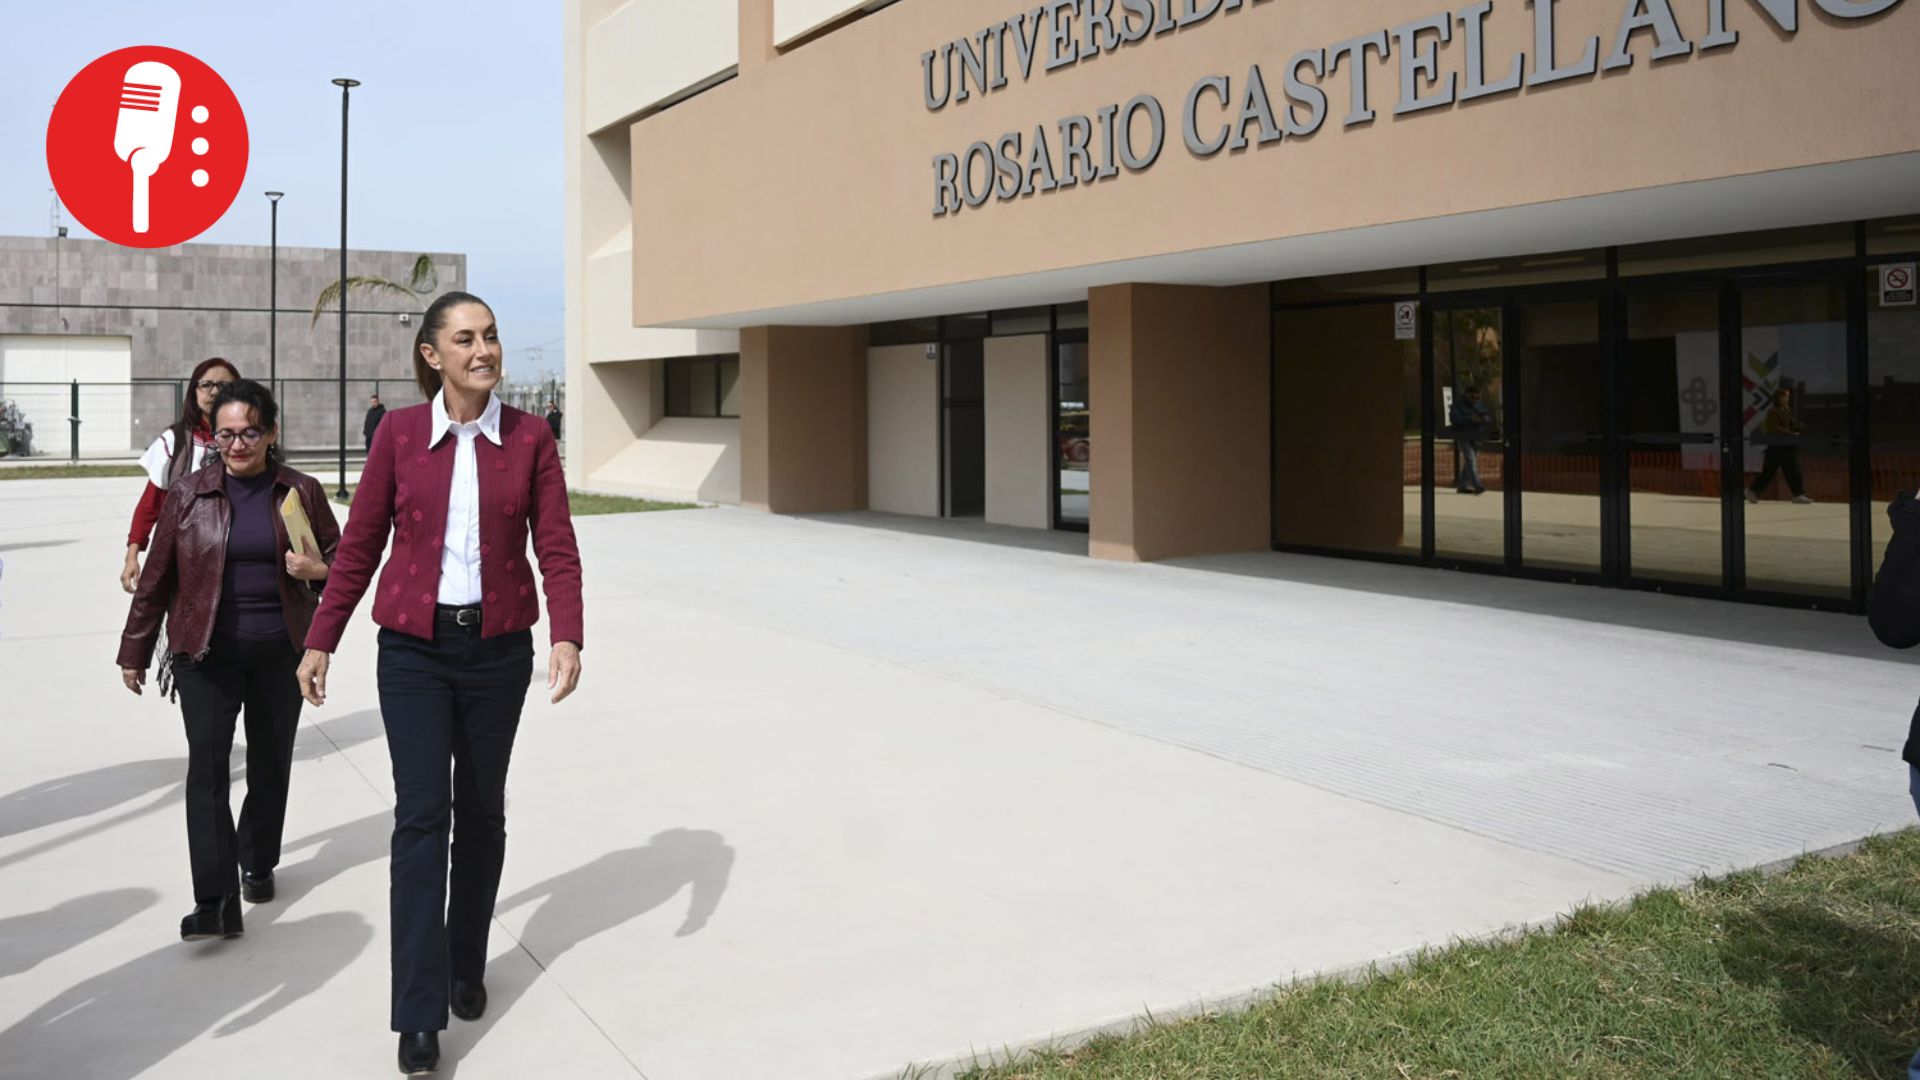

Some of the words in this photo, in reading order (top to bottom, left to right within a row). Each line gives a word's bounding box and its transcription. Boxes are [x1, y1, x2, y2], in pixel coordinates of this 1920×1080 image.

[921, 0, 1258, 111] UNIVERS
[932, 94, 1165, 216] ROSARIO
[1182, 0, 1901, 155] CASTELLA
